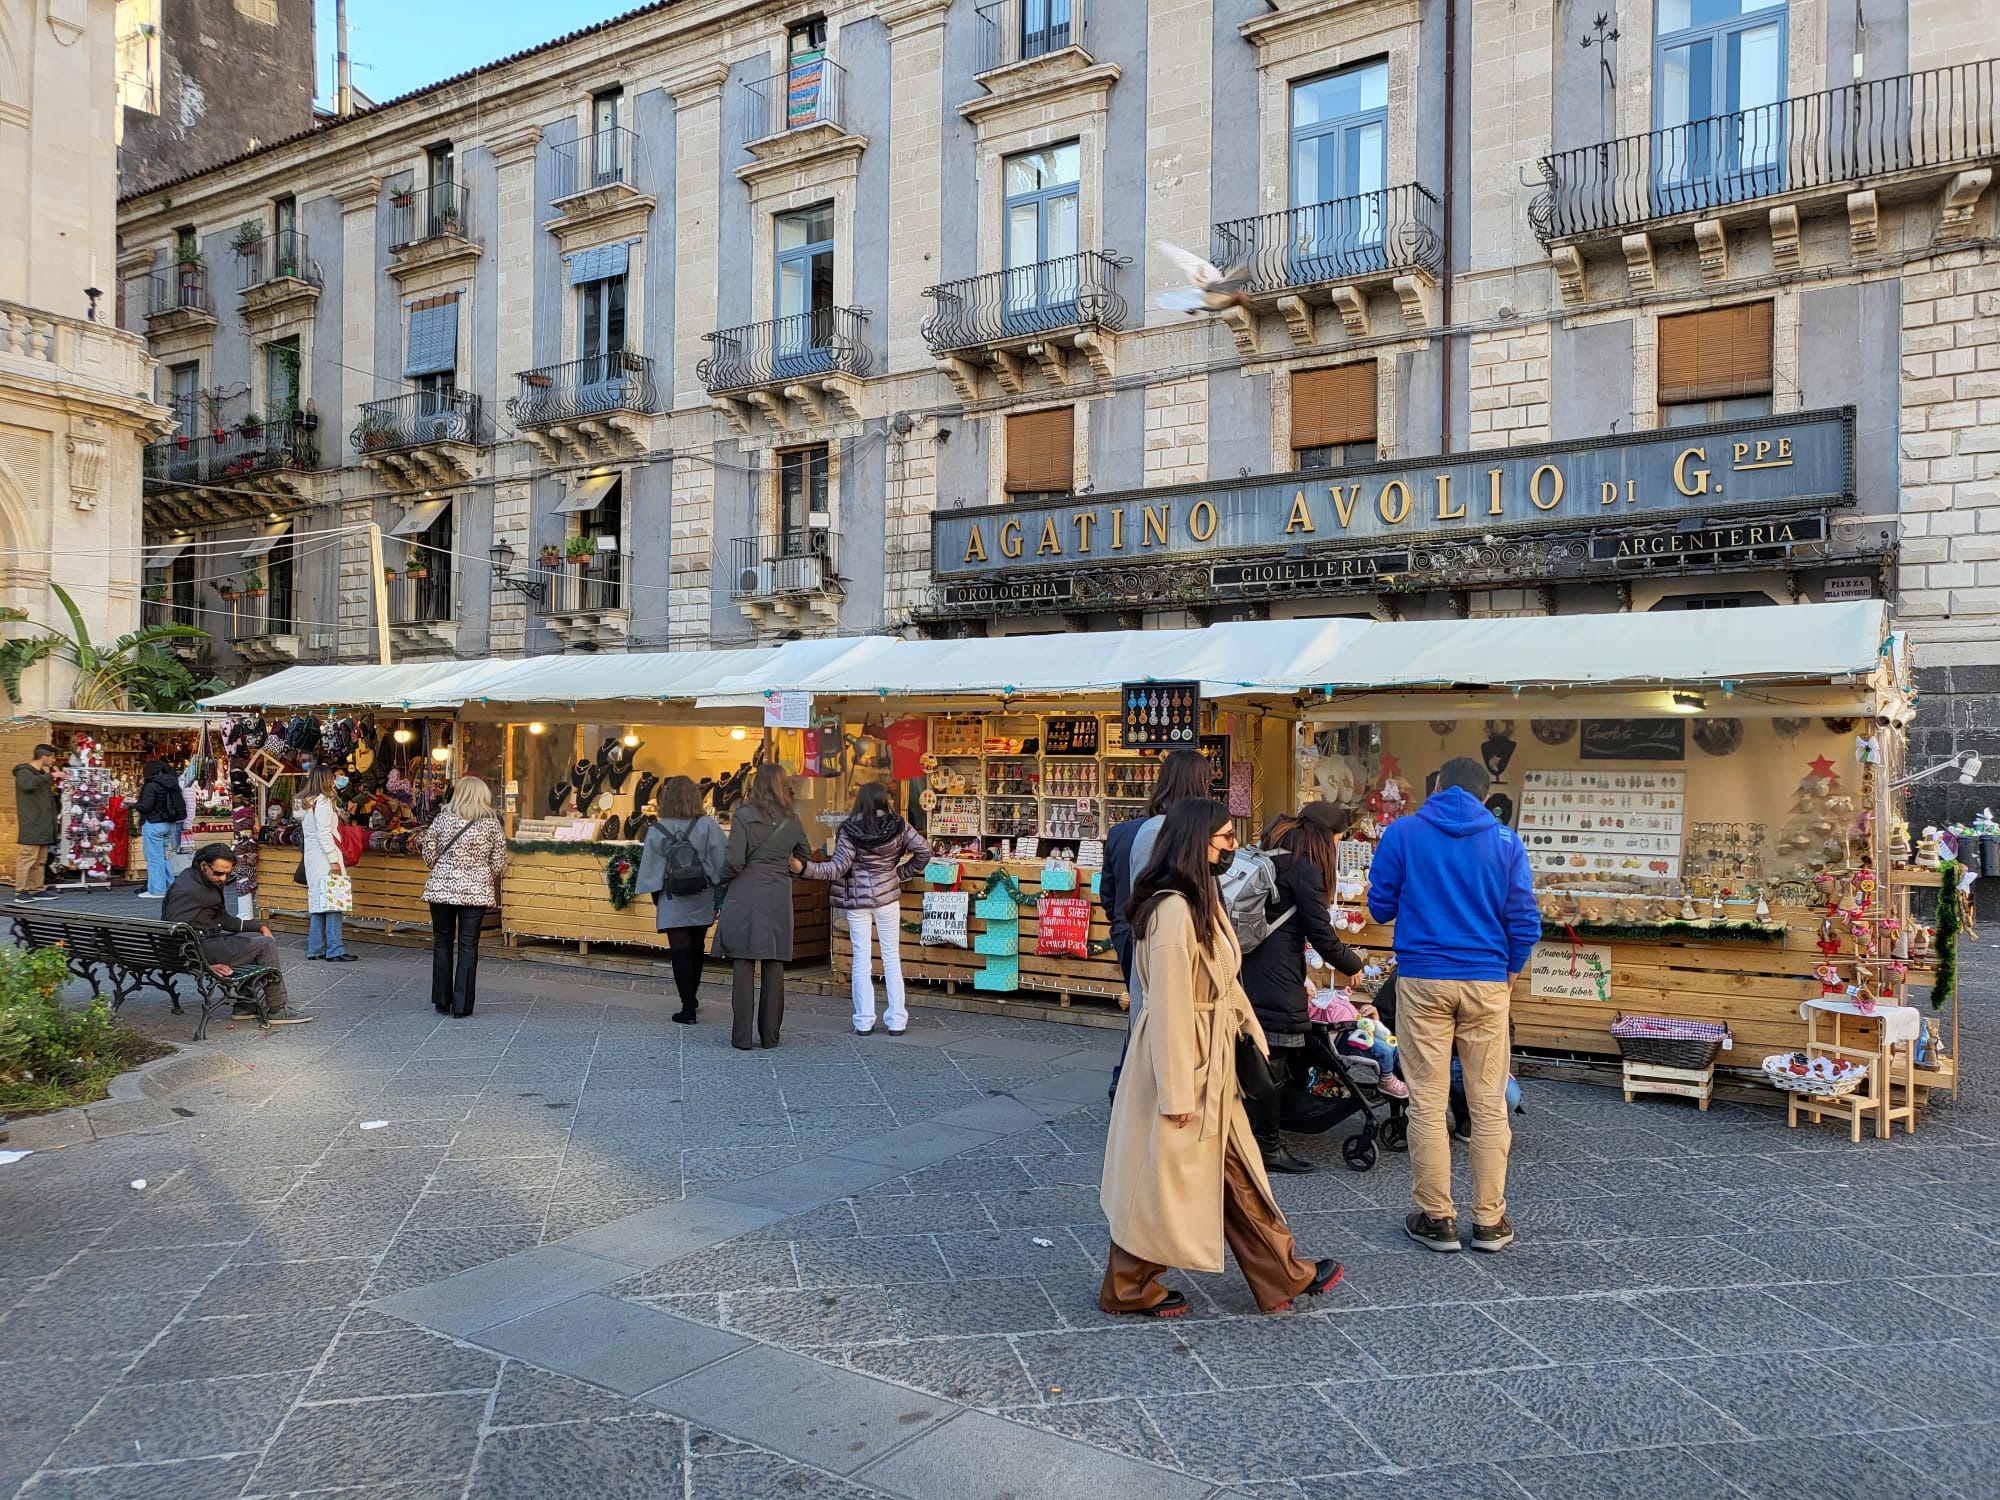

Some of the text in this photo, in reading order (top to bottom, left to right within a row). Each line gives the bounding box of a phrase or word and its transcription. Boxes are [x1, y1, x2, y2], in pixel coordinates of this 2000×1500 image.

[963, 500, 1219, 562] AGATINO
[1284, 464, 1565, 534] AVOLIO
[1600, 479, 1636, 505] DI
[1617, 524, 1795, 556] ARGENTERIA
[1241, 558, 1378, 582] GIOIELLERIA
[1831, 580, 1864, 588] PIAZZA
[958, 582, 1058, 602] OROLOGERIA
[924, 911, 956, 921] NGKOK
[1041, 939, 1088, 950] Central Park
[1575, 951, 1600, 960] made
[1532, 966, 1550, 975] with
[1542, 985, 1594, 996] cactus fiber
